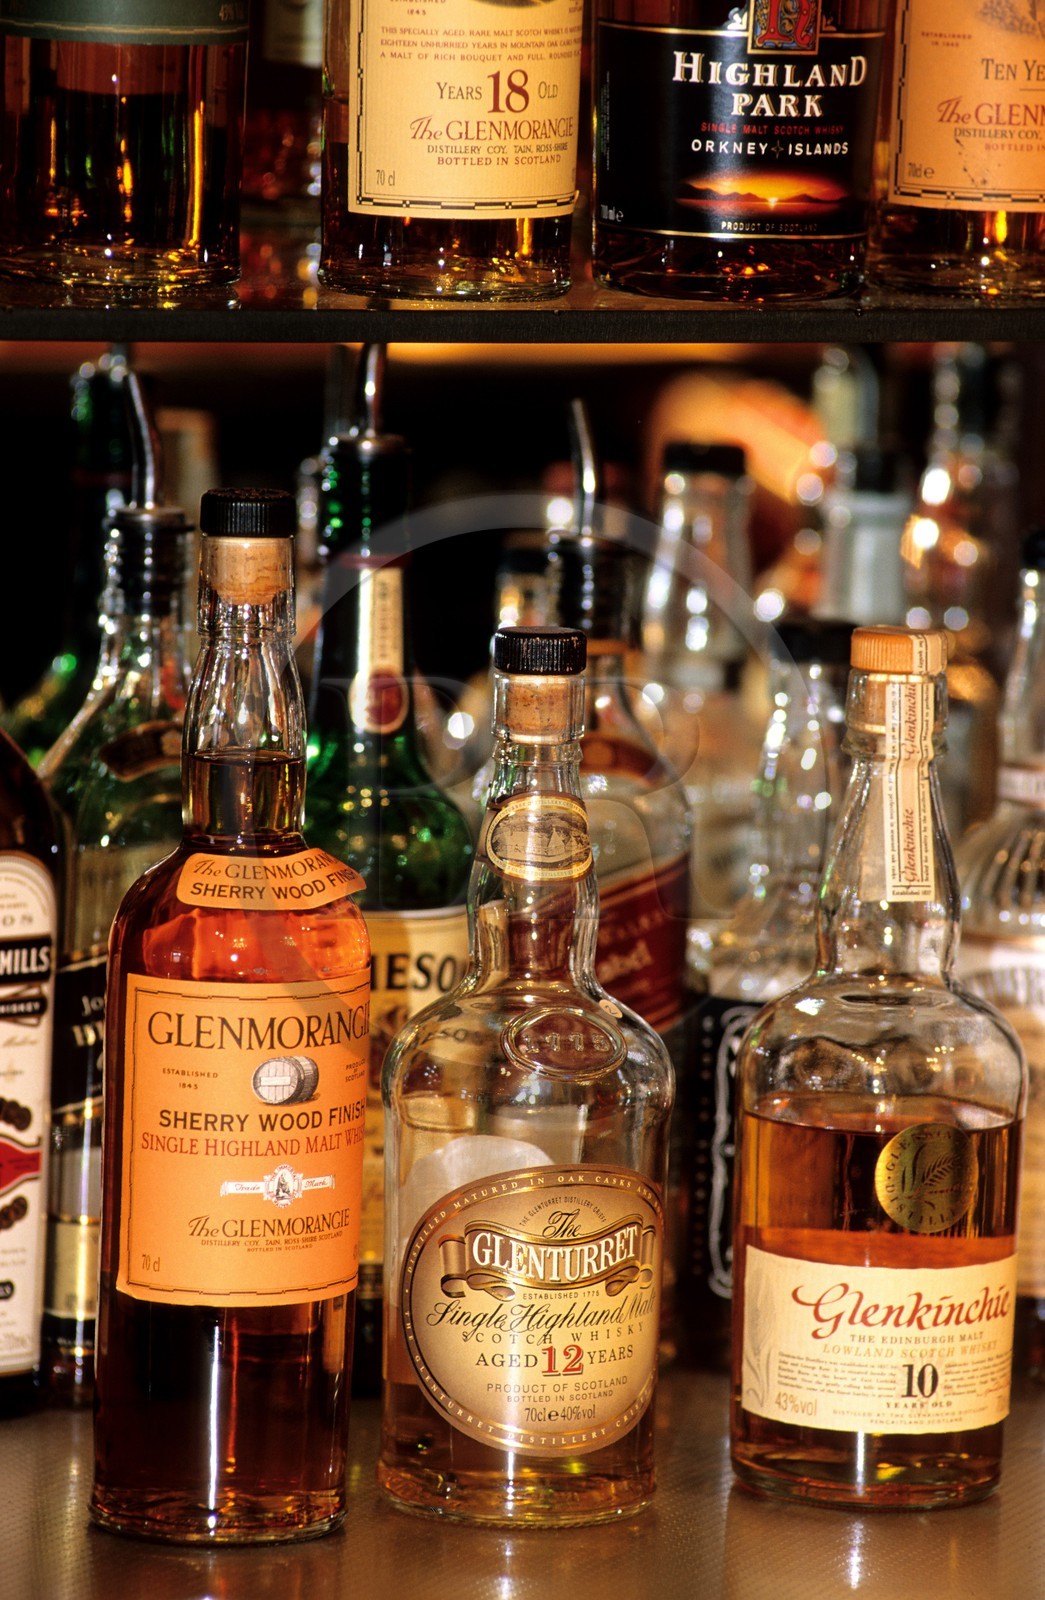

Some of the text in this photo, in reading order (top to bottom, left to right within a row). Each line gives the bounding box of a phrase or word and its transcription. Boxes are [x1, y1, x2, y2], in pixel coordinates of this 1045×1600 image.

[399, 27, 439, 36] SPECIALLY
[380, 38, 418, 47] EIGHTEEN
[421, 40, 468, 49] UNHURRIED
[390, 52, 412, 60] MALT
[418, 52, 428, 60] OF
[460, 54, 502, 62] BOUQUET
[671, 50, 868, 88] HIGHLAND
[981, 58, 1018, 81] TEN
[436, 69, 558, 114] YEARS 18 OLD
[730, 92, 824, 118] PARK
[936, 96, 971, 124] The
[410, 115, 574, 141] The GLENMORANGIE
[700, 122, 844, 136] SINGLE MALT SCOTCH WHISKY
[954, 128, 1015, 139] DISTILLERY
[427, 144, 482, 154] DISTILLERY
[690, 138, 849, 156] ORKNEY ISLANDS
[984, 143, 1033, 152] BOTTLED
[437, 155, 562, 166] BOTTLED IN SCOTLAND
[376, 170, 396, 186] 70 cl
[721, 220, 762, 232] PRODUCT
[765, 222, 775, 232] OF
[193, 858, 220, 878] The
[190, 882, 266, 900] SHERRY
[271, 879, 327, 900] WOOD
[605, 1004, 618, 1015] 2
[523, 1032, 611, 1054] 1775
[162, 1068, 219, 1078] ESTABLISHED
[159, 1096, 366, 1132] SHERRY WOOD FINISH
[141, 1132, 200, 1155] SINGLE
[204, 1138, 301, 1158] HIGHLAND
[306, 1132, 342, 1154] MALT
[234, 1179, 328, 1192] Trade Mark
[528, 1196, 562, 1217] GLENTURRET
[564, 1196, 594, 1210] DISTILLERY
[188, 1208, 351, 1239] The GLENMORANGIE
[408, 1211, 446, 1274] DISTILLED
[452, 1182, 519, 1208] MATURED
[530, 1177, 545, 1186] IN
[558, 1174, 586, 1183] OAK
[596, 1176, 632, 1188] CASKS
[542, 1208, 583, 1240] The
[200, 1238, 240, 1247] DISTILLERY
[318, 1230, 343, 1242] SCOTLAND
[284, 1244, 313, 1252] SCOTLAND
[142, 1254, 160, 1273] 70 cl
[472, 1225, 640, 1283] GLENTURRET
[522, 1290, 600, 1301] ESTABLISHED 1775
[791, 1282, 1009, 1340] Glenkinchie
[426, 1300, 507, 1340] Single
[509, 1296, 628, 1346] Highland
[462, 1322, 645, 1345] SCOTCH WHISKY
[850, 1331, 984, 1345] THE EDINBURGH MALT
[822, 1339, 999, 1358] LOWLAND SCOTCH WHISKY
[475, 1344, 634, 1377] AGED 12 YEARS
[486, 1376, 628, 1394] PRODUCT OF SCOTLAND
[900, 1363, 939, 1399] 10
[414, 1354, 494, 1434] GLENTURRET
[508, 1428, 607, 1446] DISTILLERY
[506, 1390, 614, 1404] BOTTLED IN SCOTLAND
[886, 1400, 953, 1410] YEARS OLD
